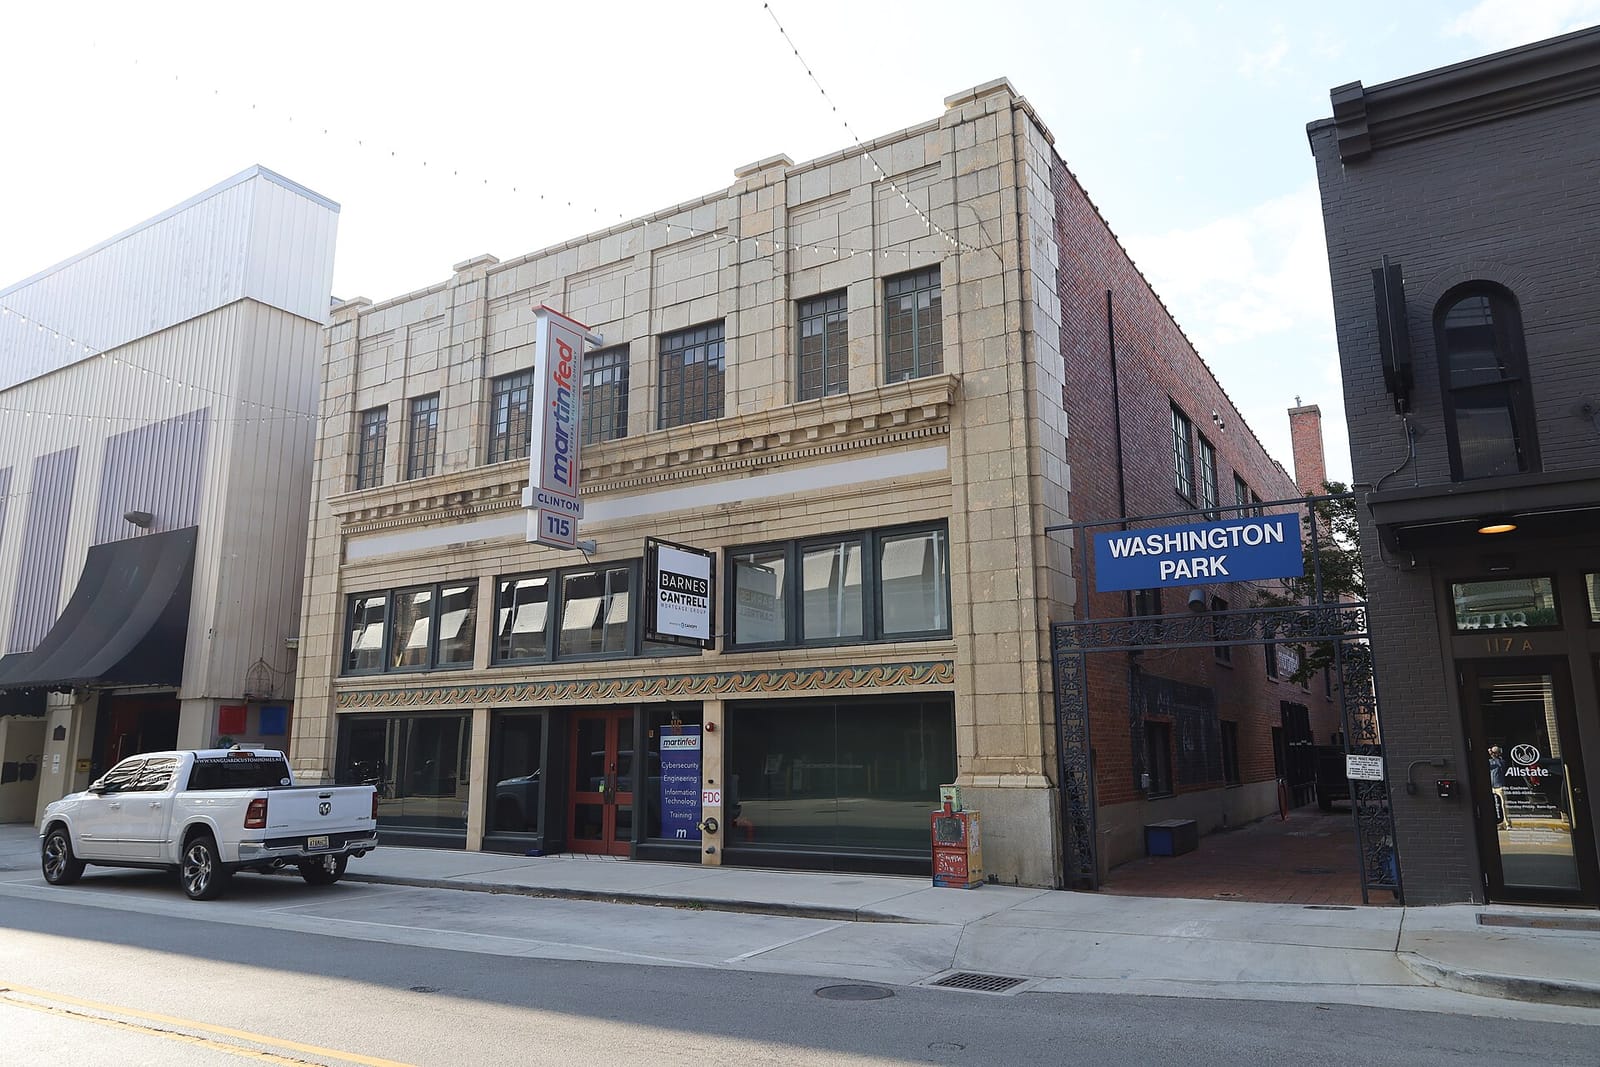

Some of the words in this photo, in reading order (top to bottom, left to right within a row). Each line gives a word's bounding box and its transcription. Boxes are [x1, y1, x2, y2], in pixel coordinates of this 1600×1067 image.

[552, 337, 574, 485] martinfed
[537, 493, 580, 512] CLINTON
[547, 516, 570, 537] 115
[1108, 522, 1284, 558] WASHINGTON
[1159, 555, 1229, 581] PARK
[662, 573, 706, 594] BARNES
[660, 591, 707, 609] CANTRELL
[1487, 638, 1513, 652] 117
[1523, 640, 1533, 651] A
[663, 737, 697, 746] martinfed
[661, 762, 699, 770] Cybersecurity
[1505, 767, 1549, 777] Allstate
[663, 775, 698, 784] Engineering
[664, 788, 697, 796] Information
[702, 791, 720, 803] FDC
[664, 797, 697, 807] Technology
[669, 811, 693, 820] Training
